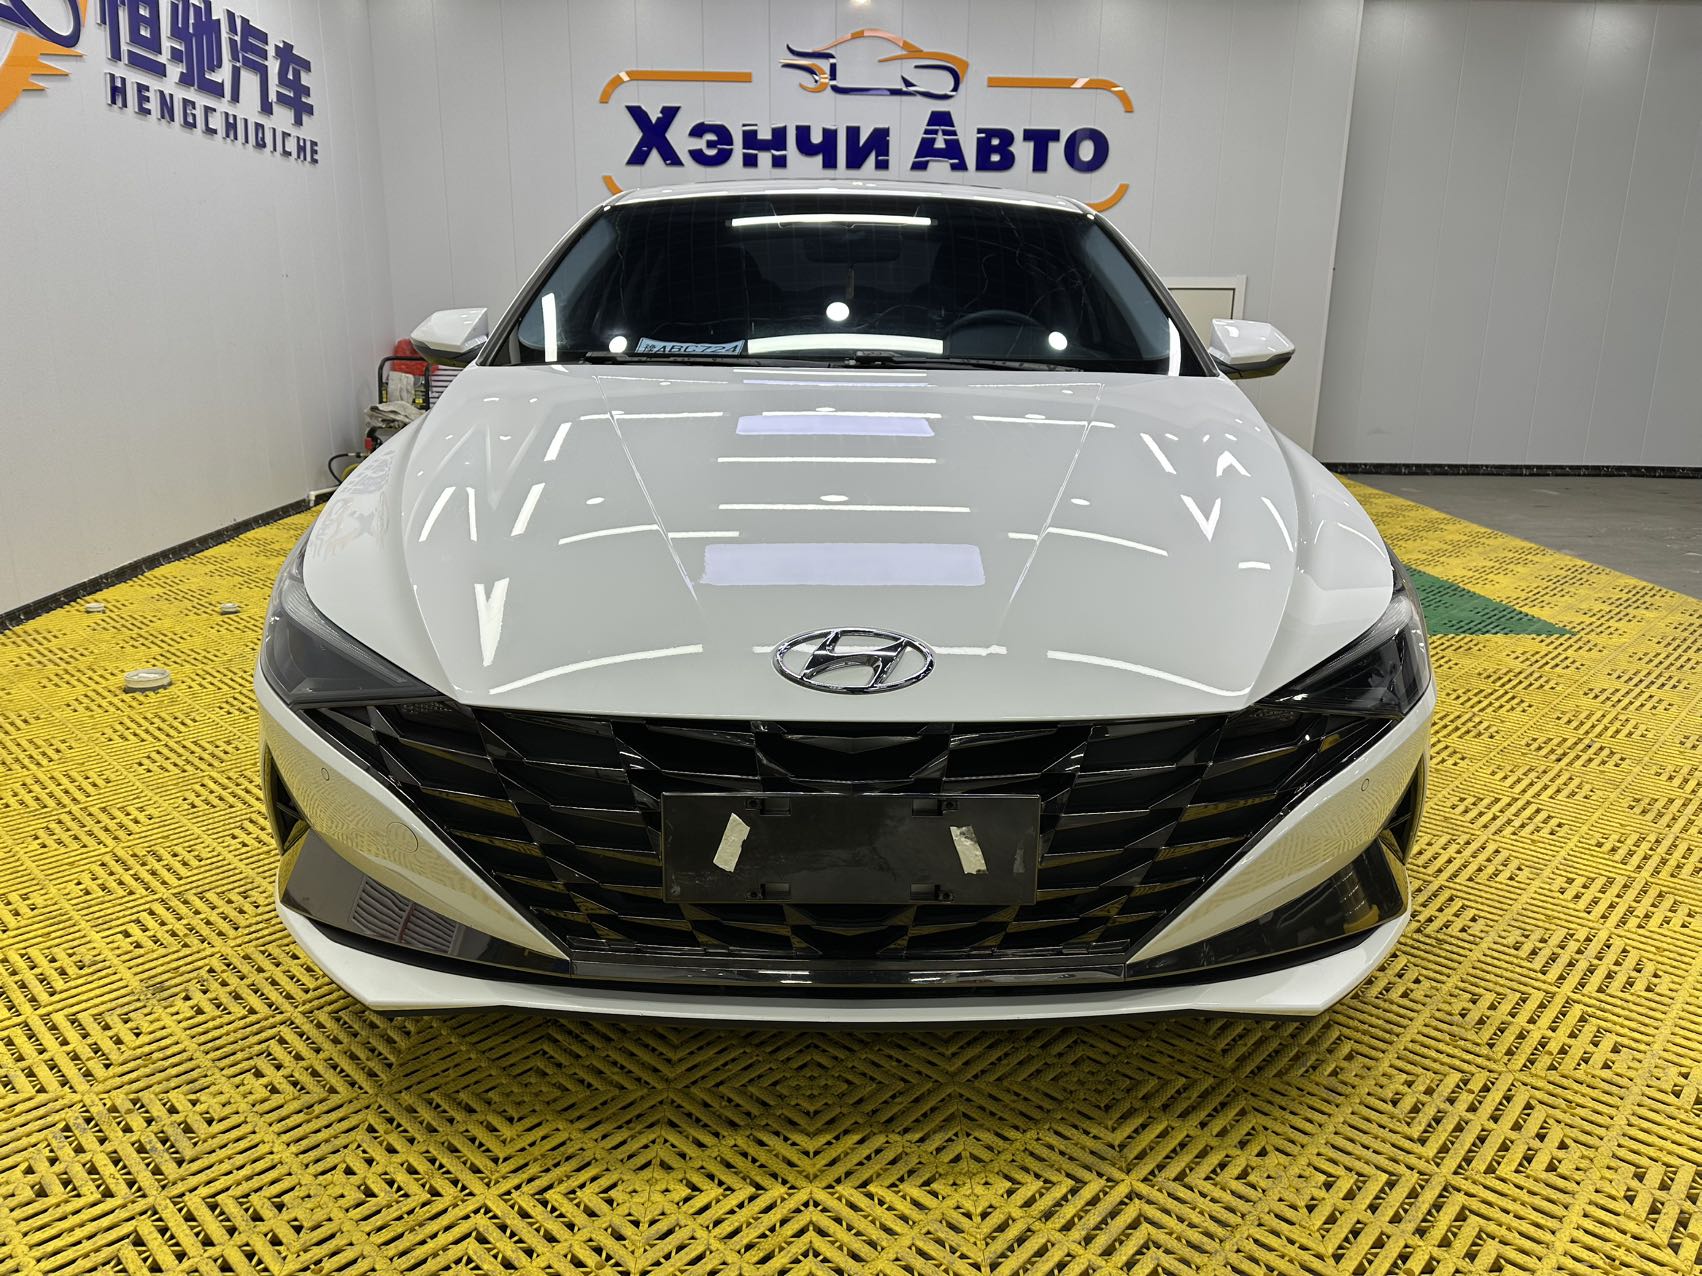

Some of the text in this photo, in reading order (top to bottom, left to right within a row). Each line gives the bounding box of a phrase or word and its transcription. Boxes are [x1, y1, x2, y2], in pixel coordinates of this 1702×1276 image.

[98, 0, 314, 127] 恒驰汽车
[106, 72, 319, 164] HENGCHIQICHE
[625, 105, 1110, 173] Хэнчи Авто
